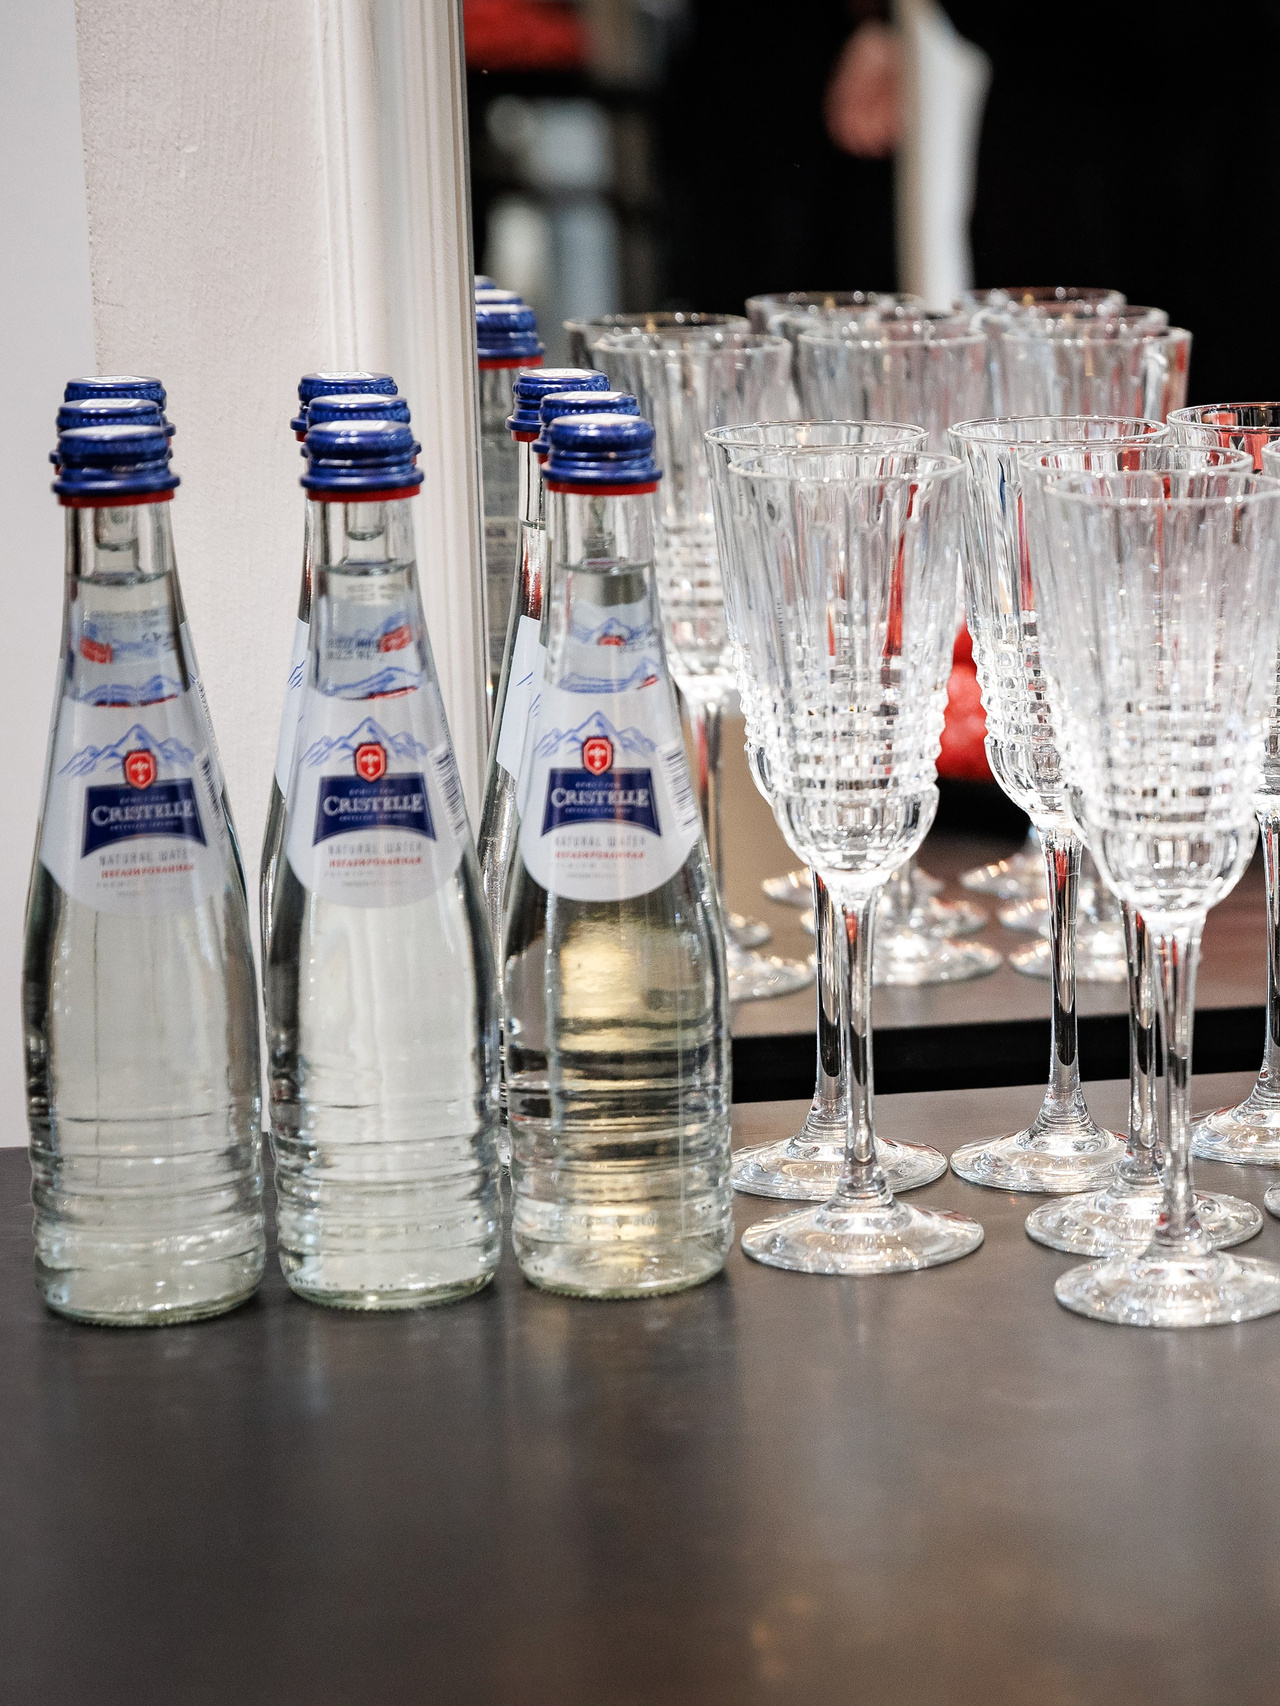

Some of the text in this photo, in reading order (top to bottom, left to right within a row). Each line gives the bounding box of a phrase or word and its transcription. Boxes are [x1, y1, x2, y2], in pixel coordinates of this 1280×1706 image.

[323, 793, 424, 817] CRISTELLE
[551, 787, 649, 809] CRISTELLE
[91, 799, 195, 827] CRISTELLE
[158, 847, 194, 862] WATE
